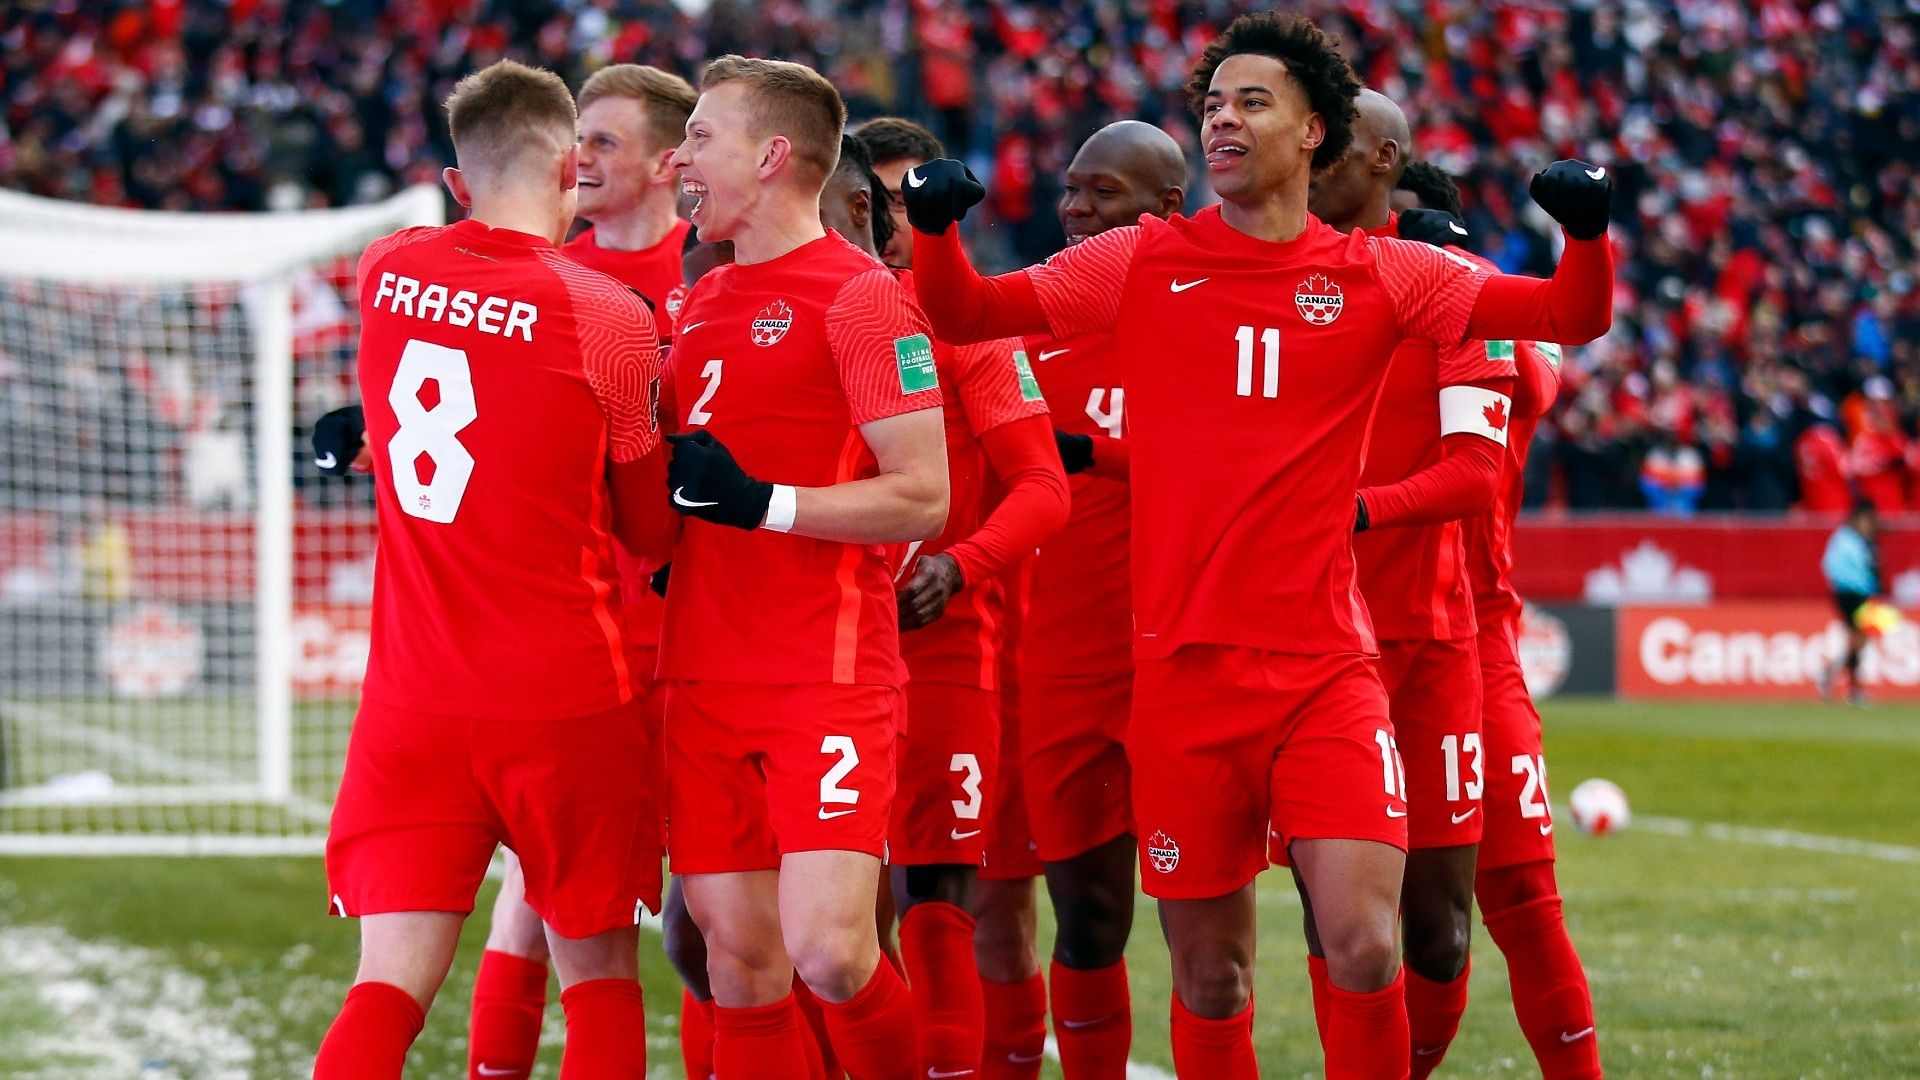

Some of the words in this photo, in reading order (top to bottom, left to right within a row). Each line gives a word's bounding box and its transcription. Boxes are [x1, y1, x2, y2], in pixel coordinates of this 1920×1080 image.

[373, 271, 538, 342] FRASER
[753, 320, 788, 328] CANADA
[1296, 295, 1342, 306] CANADA
[687, 360, 723, 426] 2
[901, 355, 931, 366] FOOTBALL
[921, 365, 935, 375] FIFA
[1235, 325, 1280, 398] 11
[387, 338, 478, 524] 8
[1085, 387, 1124, 439] 4
[820, 735, 860, 804] 2
[950, 753, 982, 820] 3
[1441, 732, 1484, 801] 13
[1149, 848, 1177, 857] CANADA
